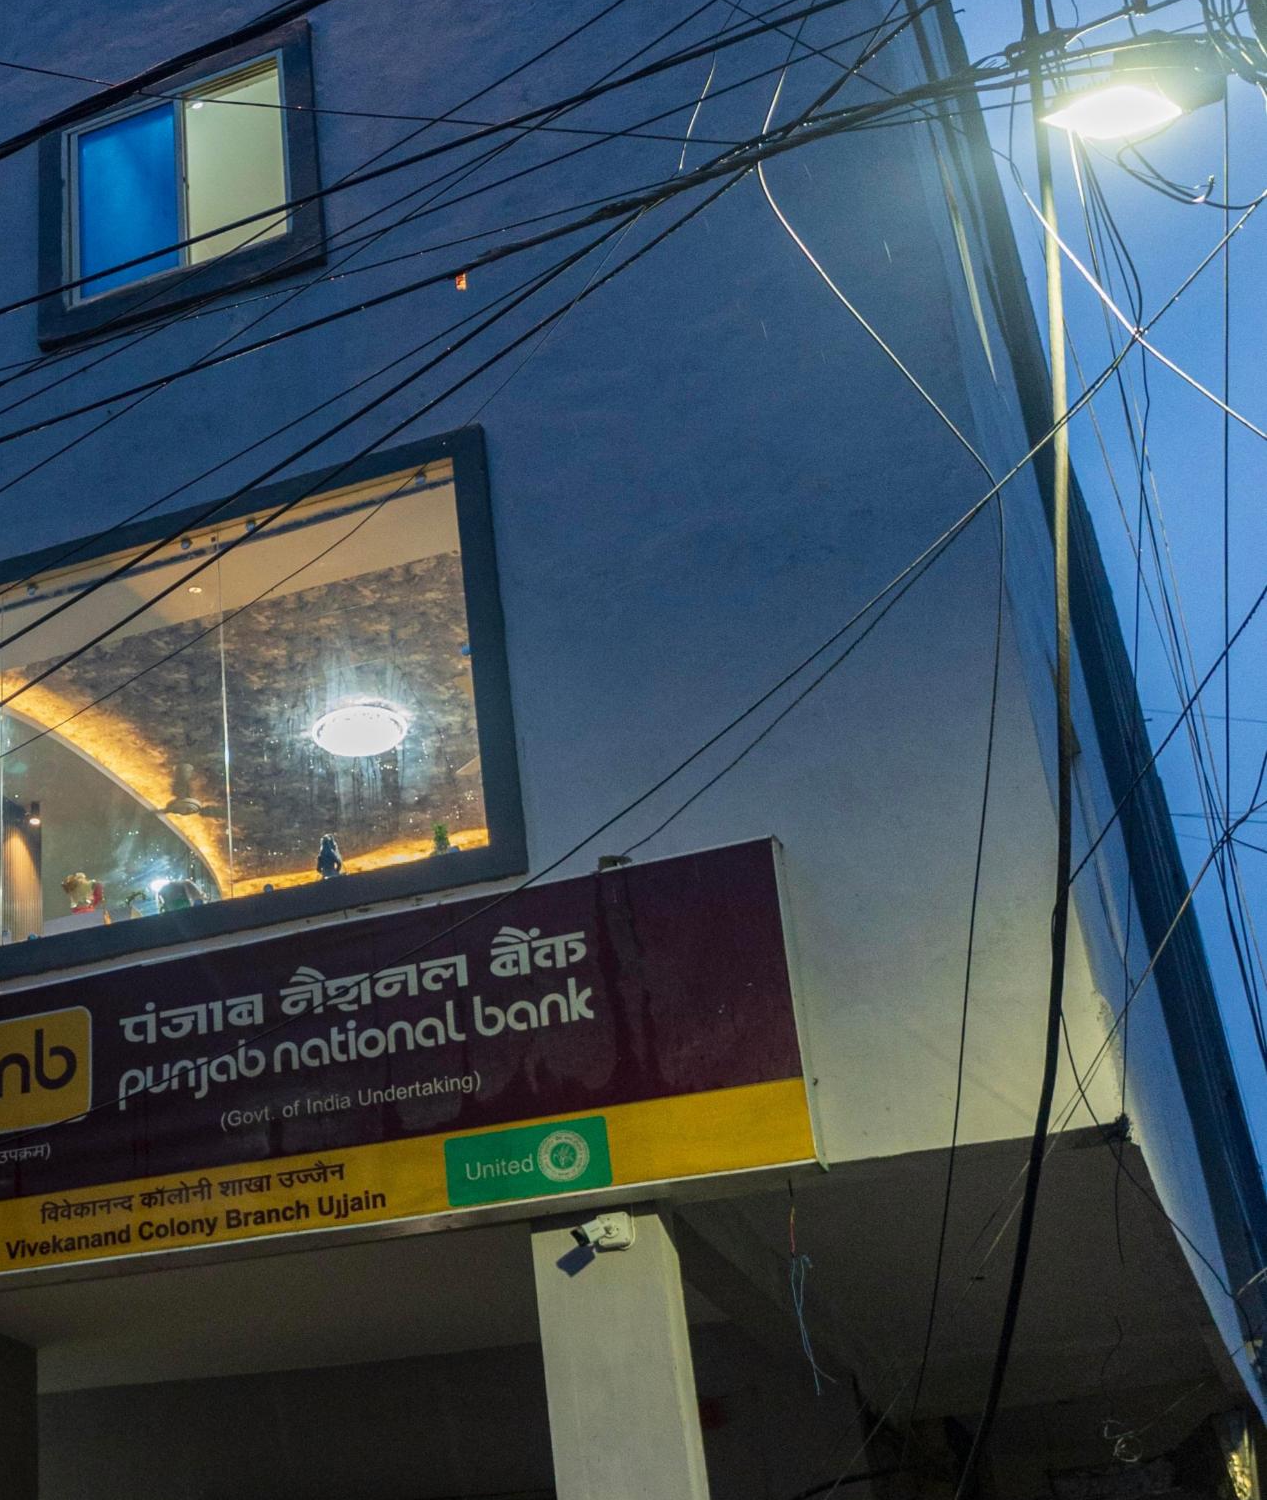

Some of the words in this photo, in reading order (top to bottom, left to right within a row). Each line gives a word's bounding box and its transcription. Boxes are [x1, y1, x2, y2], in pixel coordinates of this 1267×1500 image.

[119, 993, 264, 1044] पंजाब
[280, 954, 468, 1017] नैशनल
[489, 926, 588, 977] बैंक
[118, 1039, 266, 1110] punjab
[274, 1001, 466, 1074] national
[473, 977, 594, 1037] bank
[220, 1108, 276, 1132] (Govt.
[282, 1100, 301, 1119] of
[307, 1092, 351, 1115] India
[358, 1070, 482, 1107] Undertaking)
[220, 1174, 271, 1198] शाखा
[278, 1160, 345, 1188] उज्जैन
[465, 1153, 534, 1181] United
[5, 1224, 131, 1260] Vivekanand
[138, 1214, 218, 1242] Colony
[226, 1199, 310, 1229] Branch
[318, 1190, 387, 1219] Ujjain
